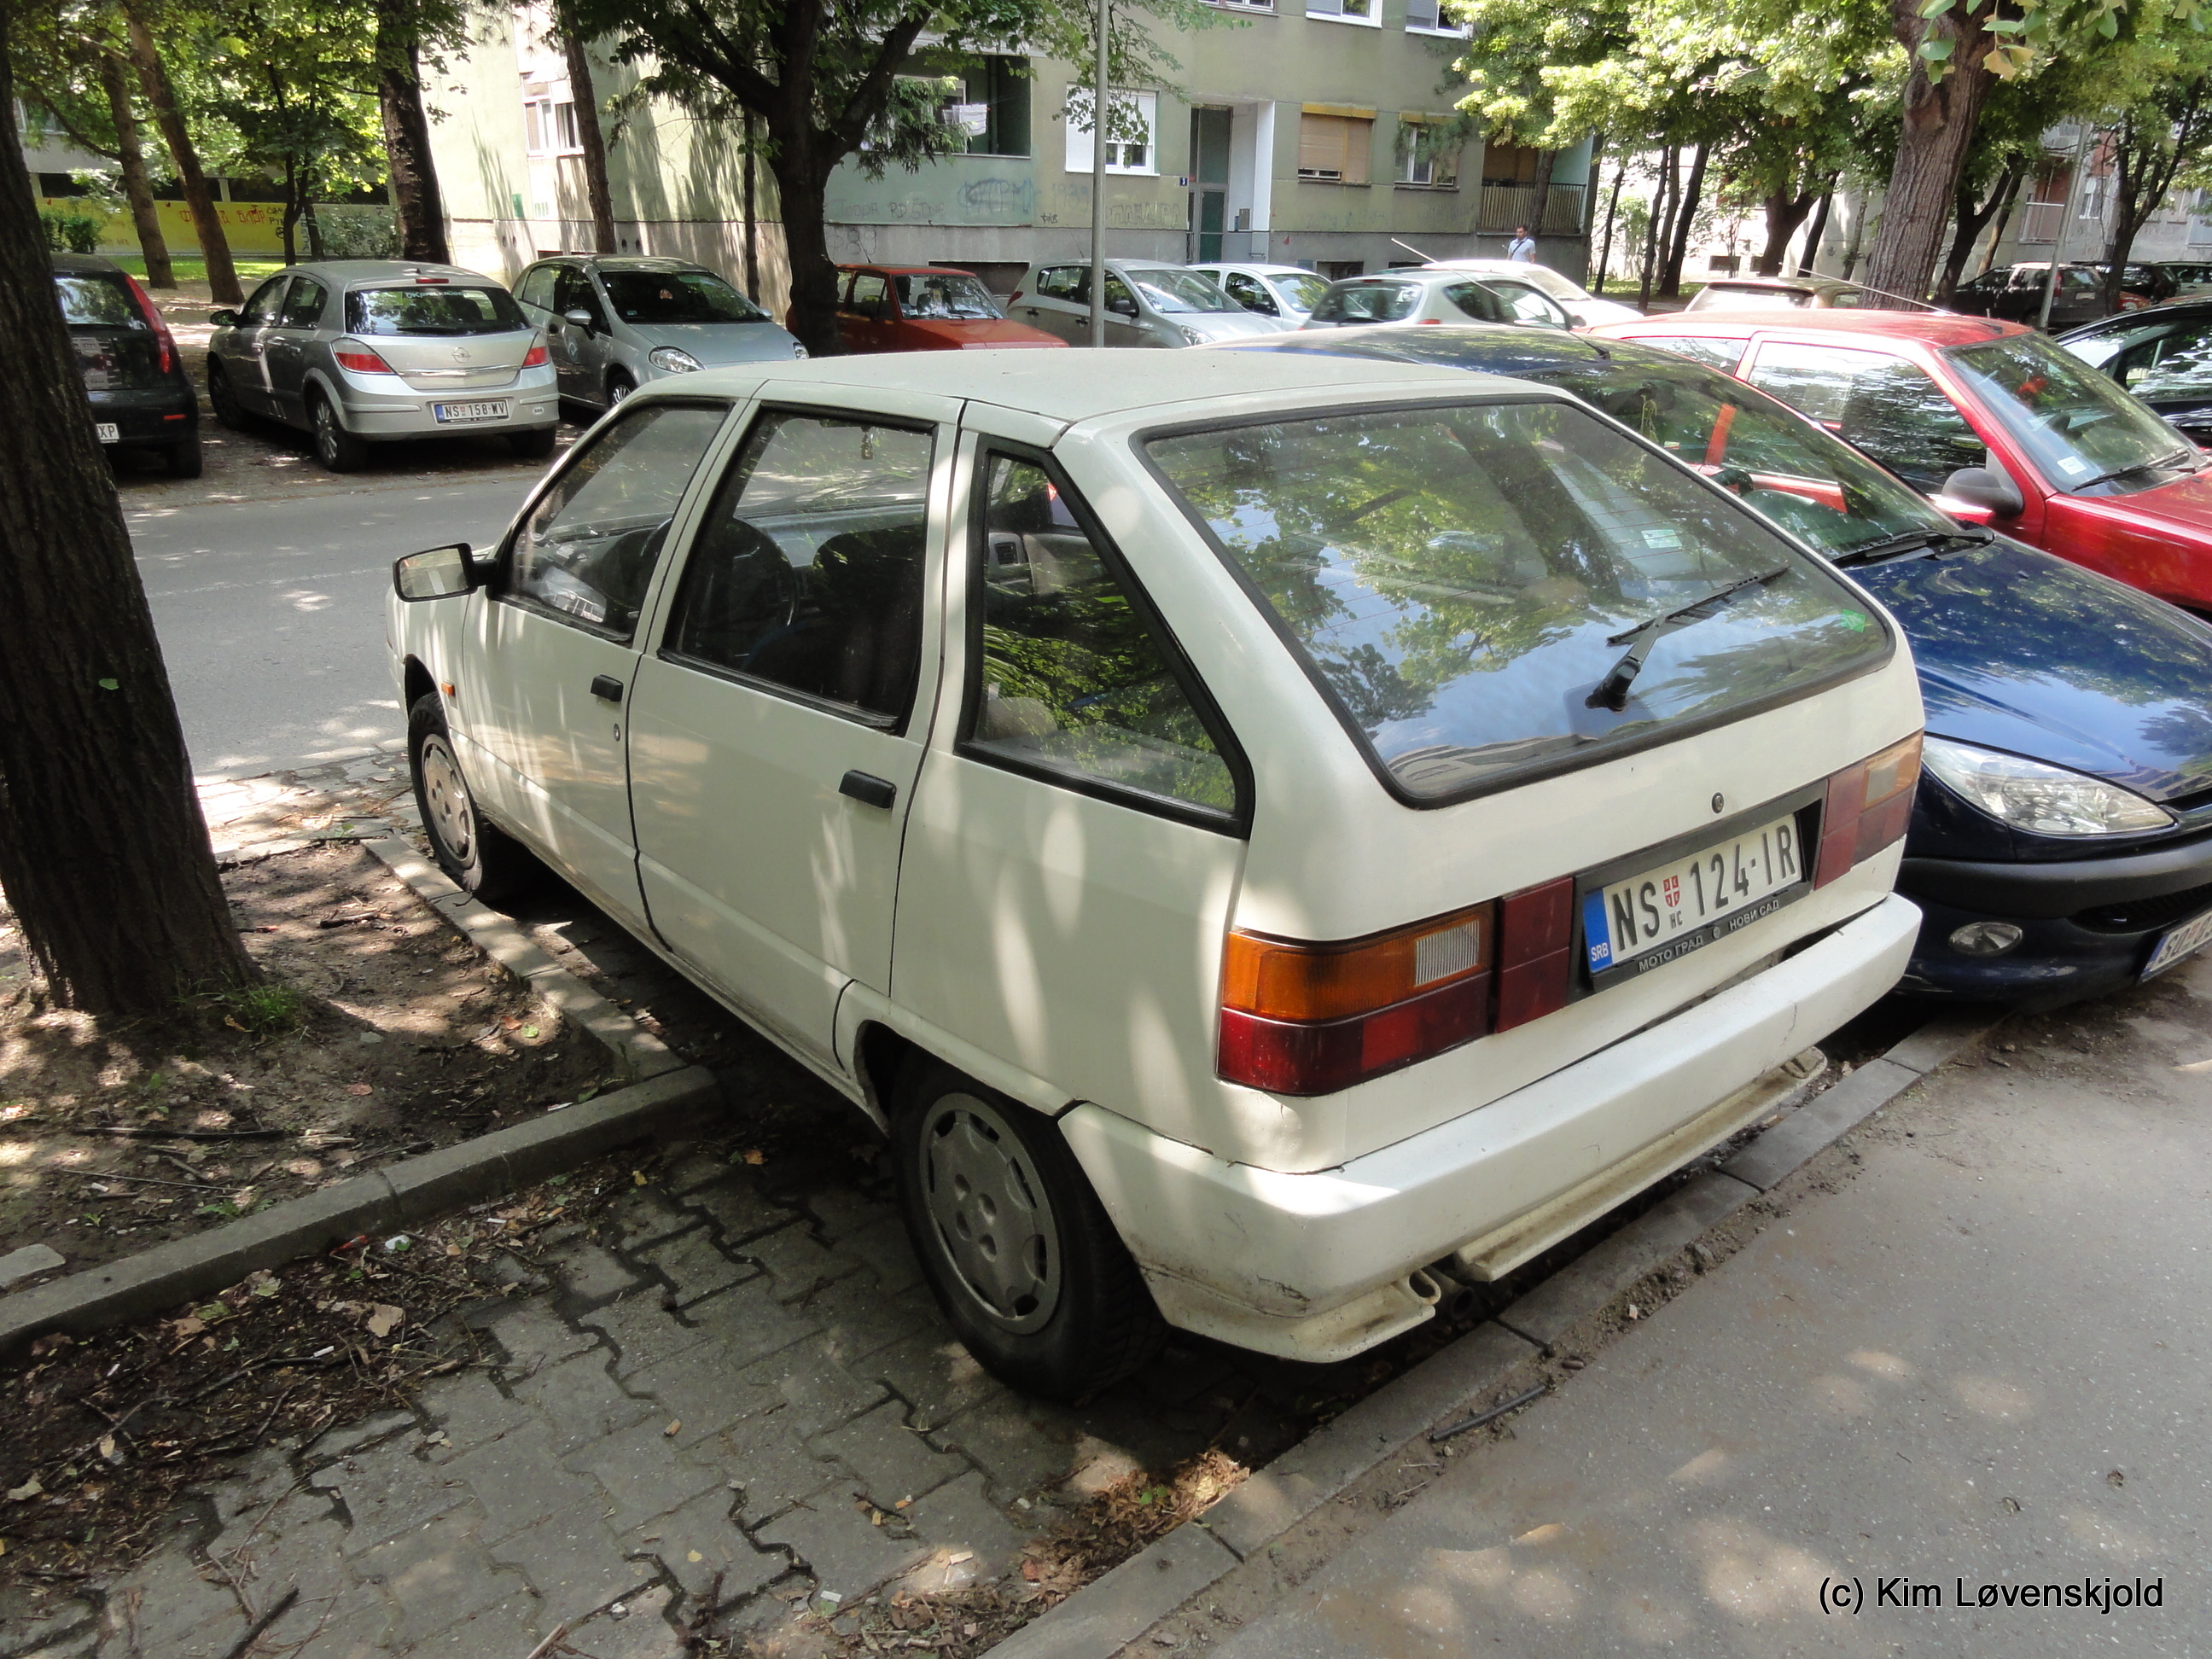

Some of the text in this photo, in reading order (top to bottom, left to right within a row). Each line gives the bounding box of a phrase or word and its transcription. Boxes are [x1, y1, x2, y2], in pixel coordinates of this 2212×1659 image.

[445, 405, 460, 418] NS
[1612, 824, 1796, 952] NS 124-IR
[1591, 941, 1610, 963] SRB
[1639, 899, 1780, 973] МОТО ГРАД НОВИ САД
